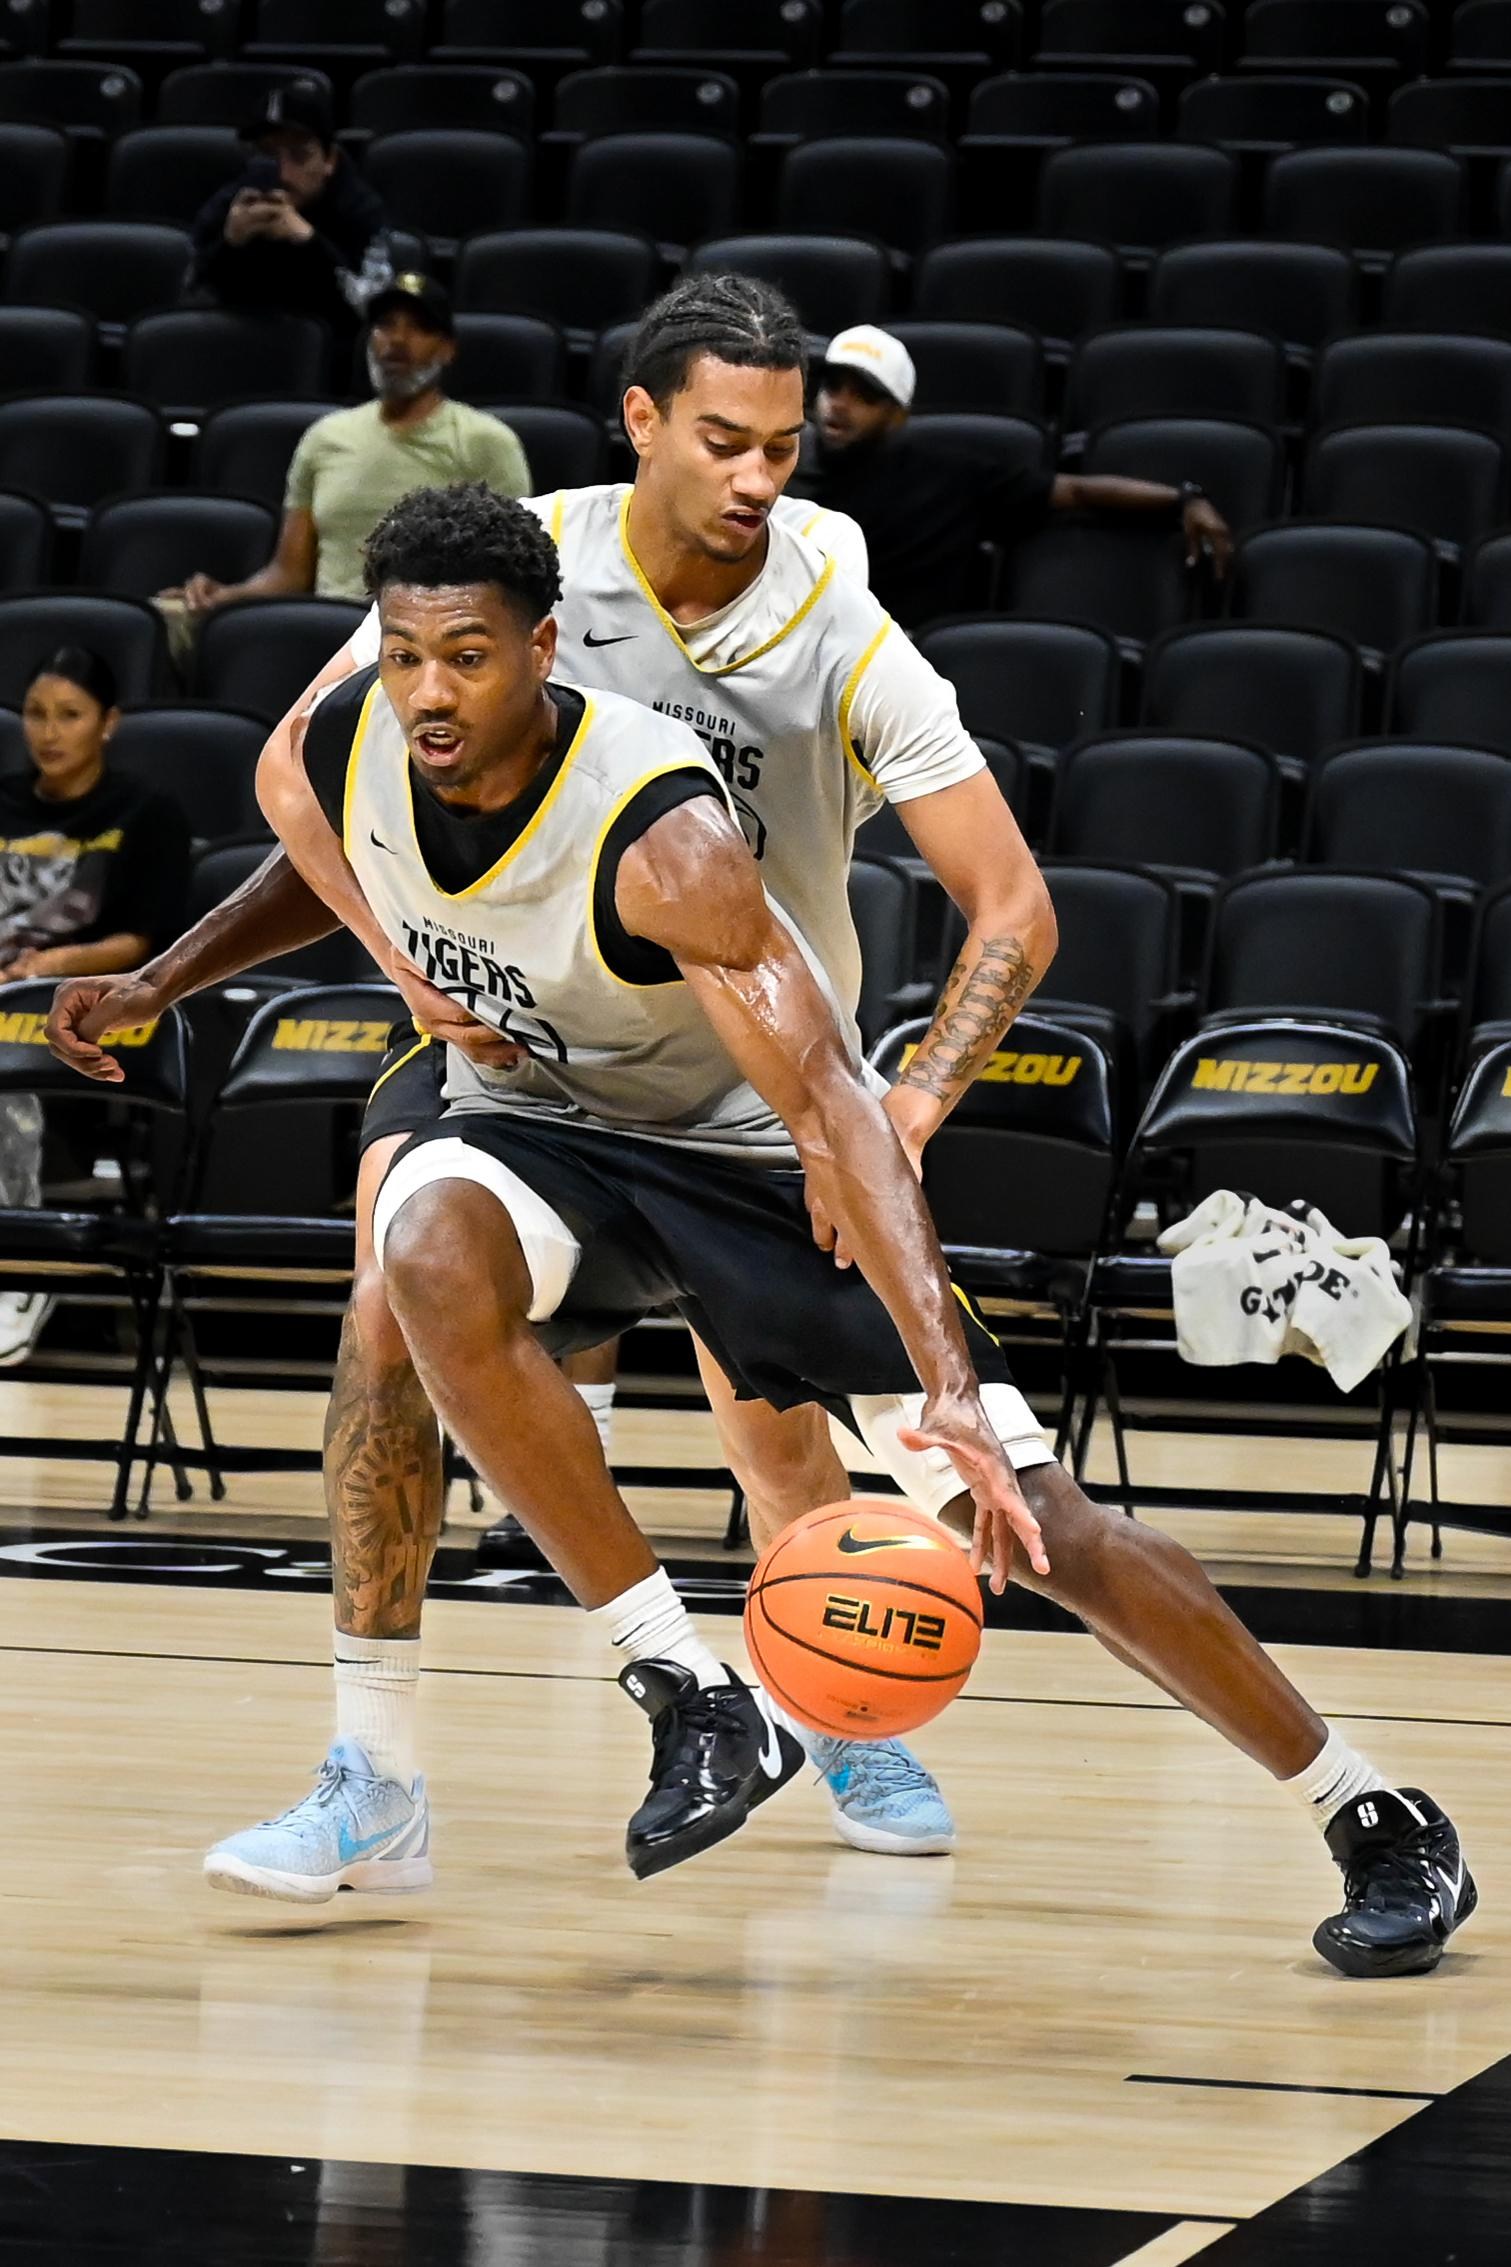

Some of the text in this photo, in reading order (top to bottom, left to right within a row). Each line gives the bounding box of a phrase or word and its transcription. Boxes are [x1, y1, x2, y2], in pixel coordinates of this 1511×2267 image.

[652, 700, 736, 736] MISSOURI
[423, 915, 495, 955] MISSOURI
[402, 919, 538, 1010] TIGERS
[272, 1018, 390, 1052] MIZZ
[1191, 1058, 1380, 1095] MIZZOU
[822, 1594, 947, 1652] ELITE
